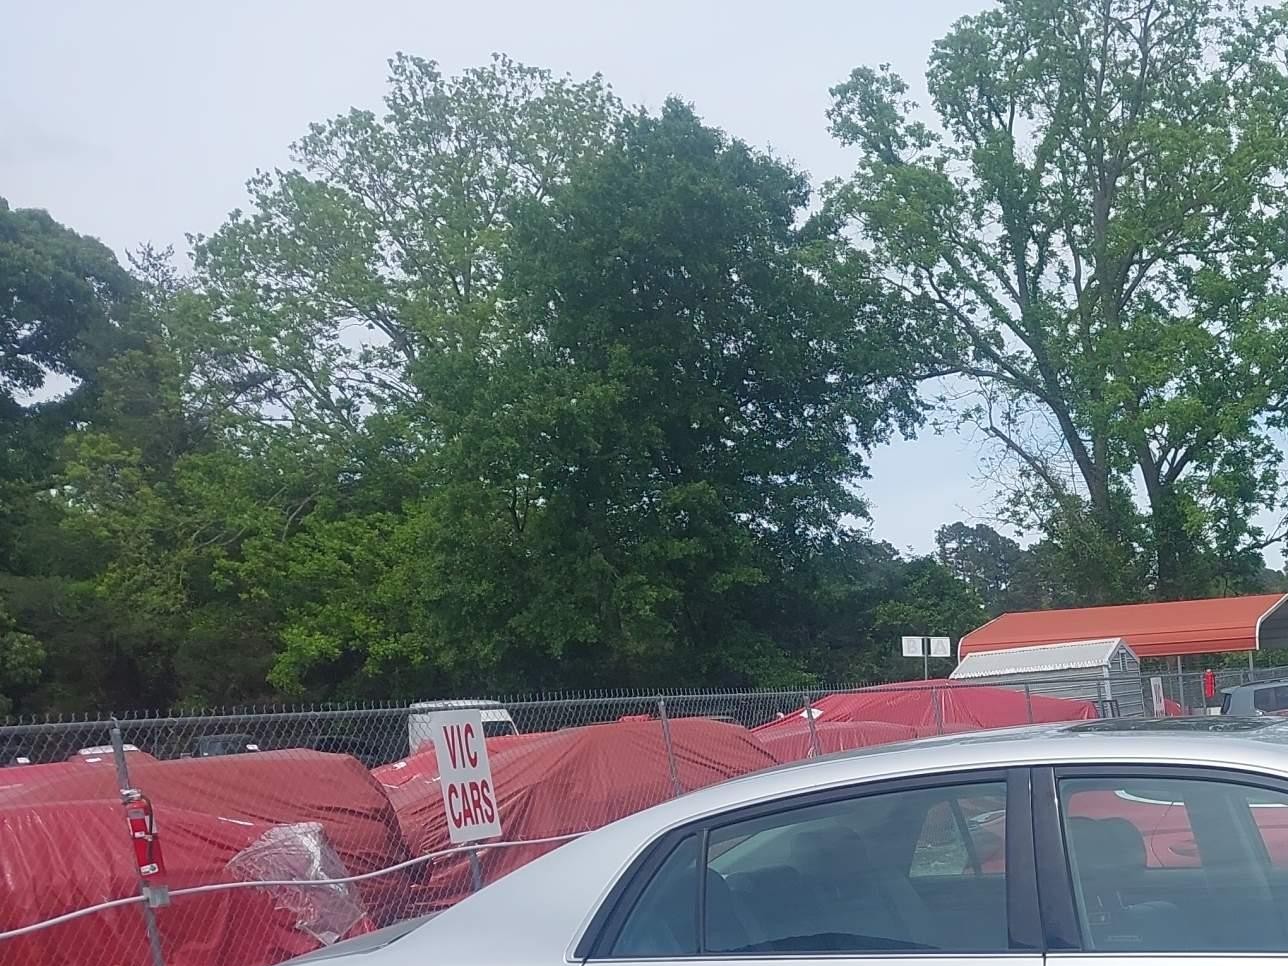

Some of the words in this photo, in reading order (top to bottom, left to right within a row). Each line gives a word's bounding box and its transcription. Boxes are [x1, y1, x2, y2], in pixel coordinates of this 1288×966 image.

[933, 639, 948, 655] A
[443, 723, 478, 769] VIC
[448, 779, 495, 829] CARS
